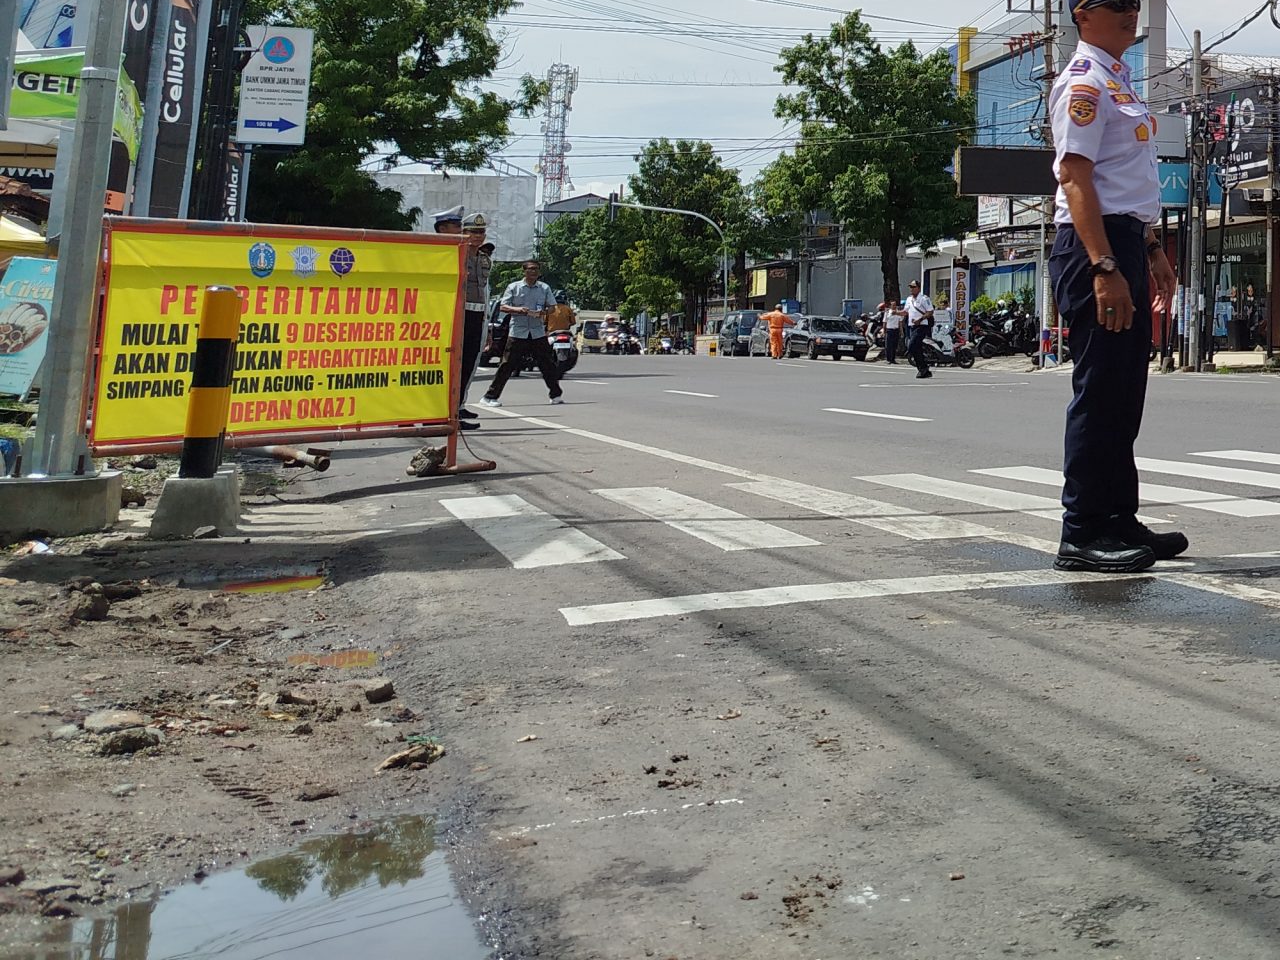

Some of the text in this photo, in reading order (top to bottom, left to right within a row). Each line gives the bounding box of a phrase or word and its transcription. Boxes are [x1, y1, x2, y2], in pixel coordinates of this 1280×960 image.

[12, 69, 76, 96] GET
[163, 19, 188, 124] Cellular
[1160, 171, 1189, 189] viv
[1223, 231, 1262, 250] SAMSUNG
[1206, 254, 1241, 262] SASUNG
[160, 284, 419, 316] PEBERITAHUAN
[121, 323, 190, 346] MULAI
[286, 322, 299, 344] 9
[303, 321, 396, 343] DESEMBER
[399, 321, 441, 341] 2024
[113, 346, 441, 375] AKAN DIUKAN PENGAKTIFAN APILL
[106, 379, 185, 400] SIMPANG
[262, 374, 314, 392] AGUNG
[327, 371, 389, 391] THAMRIN
[400, 369, 444, 387] MENUR
[230, 400, 293, 424] DEPAN
[297, 396, 346, 420] OKAZ
